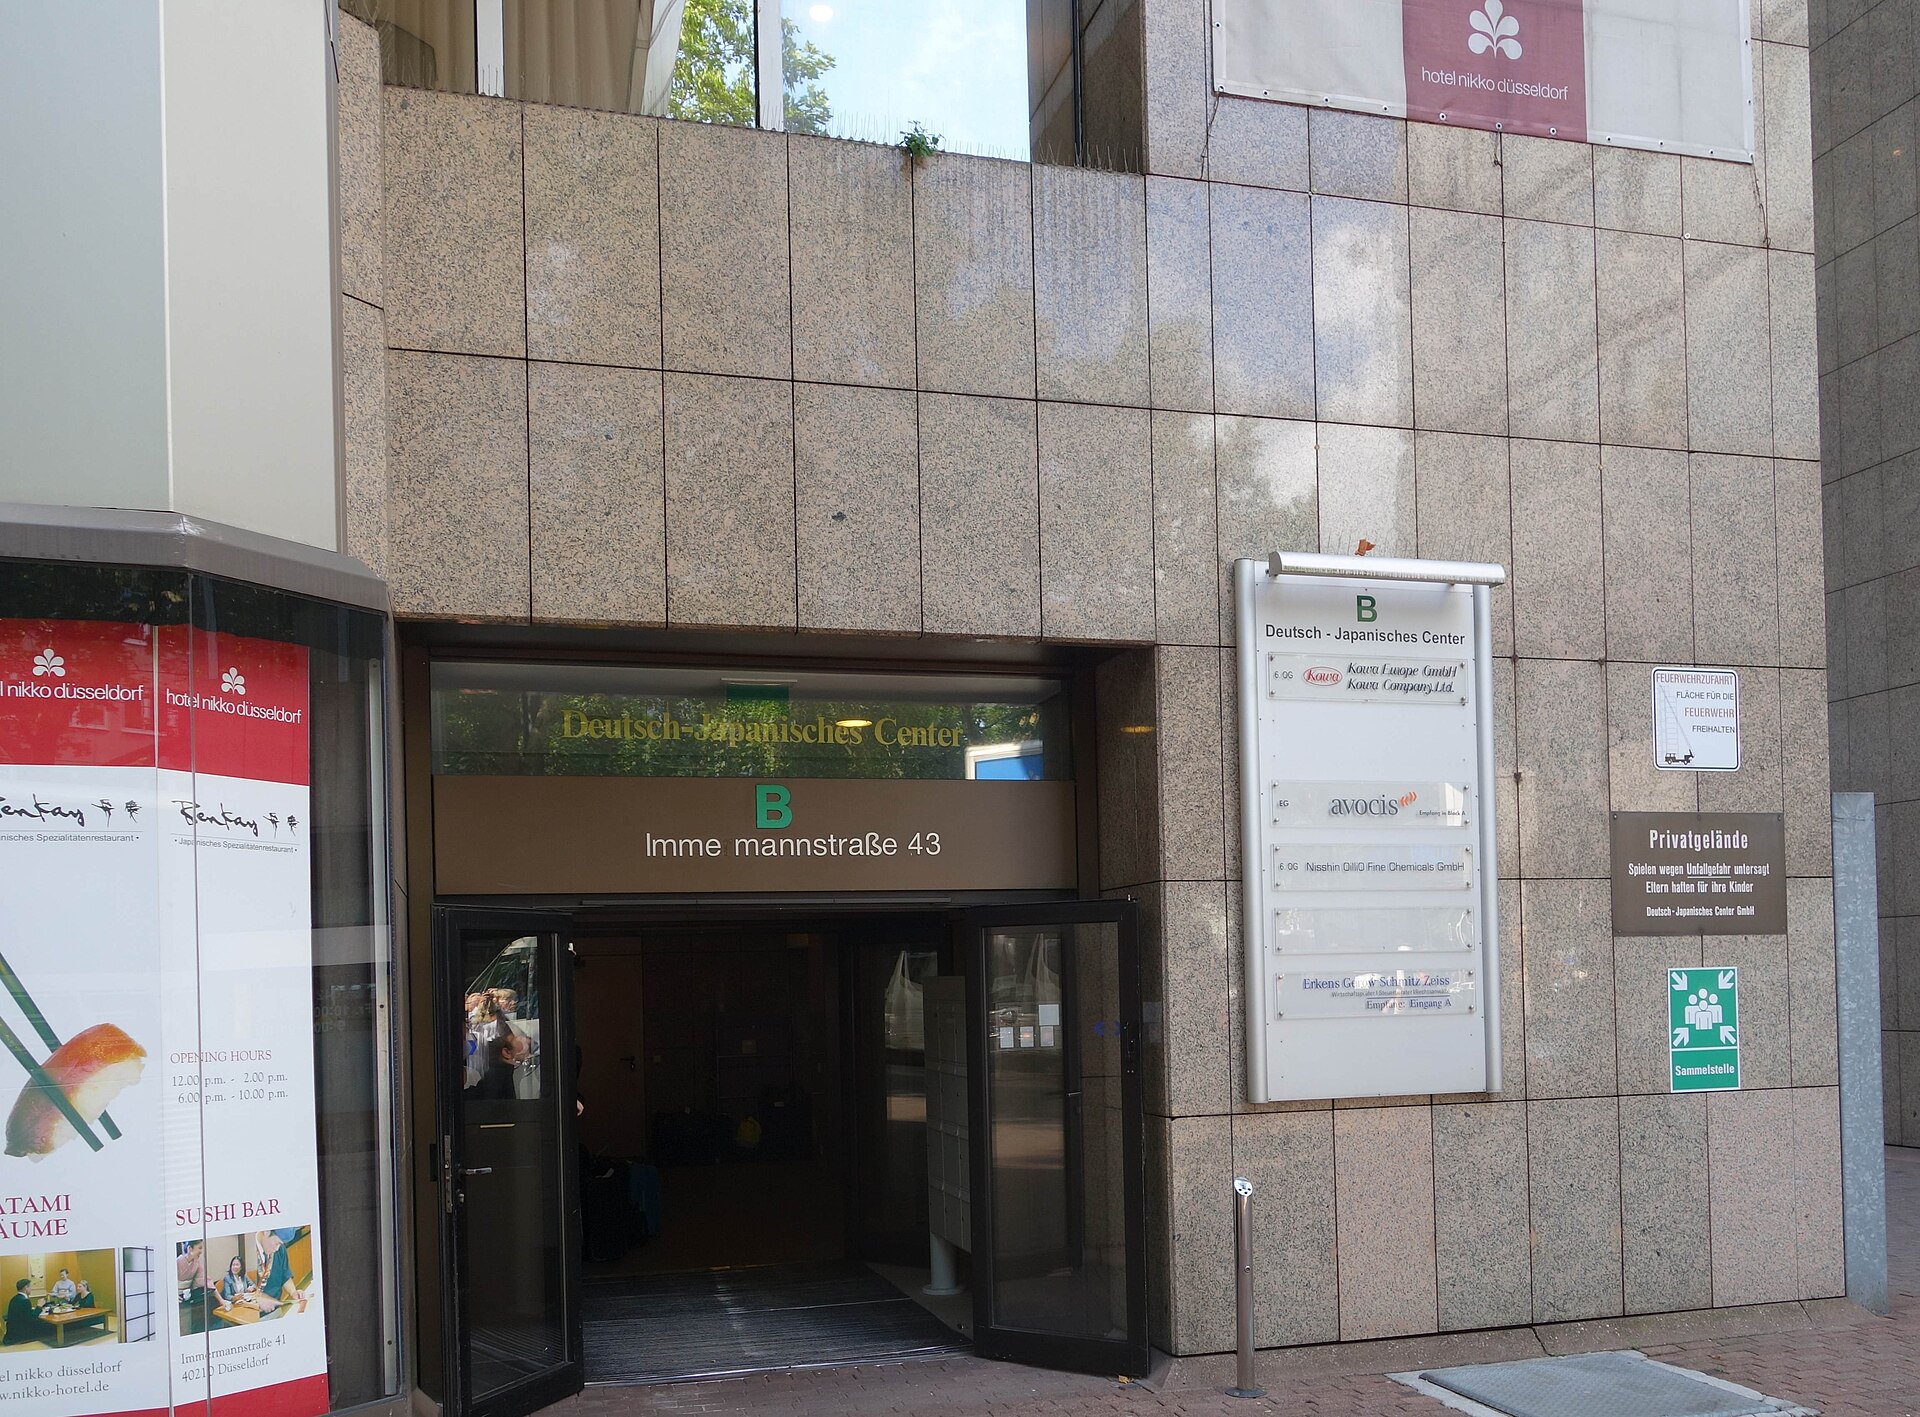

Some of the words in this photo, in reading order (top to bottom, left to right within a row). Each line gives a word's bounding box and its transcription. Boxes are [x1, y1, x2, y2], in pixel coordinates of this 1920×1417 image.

[1421, 67, 1456, 85] hotel
[1459, 73, 1495, 91] nikko
[1498, 78, 1568, 100] düsseldorf
[1356, 595, 1378, 622] B
[1265, 624, 1322, 639] Deutsch
[1334, 627, 1418, 643] Japanisches
[1422, 630, 1466, 645] Center
[1306, 669, 1340, 683] Kowa
[1347, 662, 1380, 675] Kowa
[1382, 663, 1418, 678] Europe
[1422, 664, 1457, 678] GmbH
[1347, 677, 1379, 690] Kowa
[1656, 673, 1734, 685] FEUERWEHRZUFAHRT
[8, 682, 52, 699] nikko
[54, 683, 144, 700] düsseldorf
[1676, 690, 1705, 699] FLÄCHE
[1707, 691, 1721, 699] FÜR
[166, 688, 200, 708] hotel
[202, 697, 235, 714] nikko
[237, 701, 302, 724] düsseldorf
[1685, 707, 1735, 718] FEUERWEHR
[562, 709, 862, 748] Deutsch-Japanisches
[875, 717, 964, 747] Center
[1692, 725, 1735, 733] FREIHALTEN
[0, 793, 85, 828] enkay
[755, 784, 794, 830] B
[1279, 799, 1289, 807] EG
[1331, 794, 1399, 815] avocis
[907, 832, 941, 856] 43
[1649, 830, 1748, 851] Privatgelände
[1306, 862, 1341, 872] Nisshin
[1367, 862, 1386, 872] Fine
[1389, 862, 1435, 872] Chemicals
[1437, 861, 1465, 872] GmbH
[1628, 863, 1657, 876] Spielen
[1659, 865, 1683, 876] wegen
[1686, 863, 1731, 876] Unfallgefahr
[1734, 863, 1770, 876] untersagt
[1646, 881, 1669, 893] Eltern
[1671, 881, 1695, 893] haften
[1697, 881, 1708, 893] für
[1711, 881, 1726, 893] ihre
[1729, 881, 1754, 893] Kinder
[1715, 906, 1735, 916] Center
[1737, 905, 1755, 916] GmbH
[1303, 978, 1340, 990] Erkens
[1423, 975, 1450, 986] Zeiss
[1409, 999, 1443, 1009] Eingang
[1444, 998, 1452, 1006] A
[170, 1051, 227, 1064] OPENING
[231, 1050, 272, 1062] HOURS
[1675, 1063, 1735, 1076] Sammelstelle
[172, 1074, 200, 1087] 12.00
[205, 1077, 226, 1087] p.m.
[244, 1072, 264, 1083] 2.00
[267, 1074, 288, 1084] p.m.
[178, 1092, 200, 1104] 6.00
[205, 1094, 227, 1104] p.m.
[239, 1088, 264, 1100] 10.00
[268, 1091, 288, 1101] p.m.
[175, 1203, 237, 1226] SUSHI
[242, 1198, 281, 1218] BAR
[181, 1337, 272, 1365] Immermannstraße
[275, 1334, 286, 1346] 41
[15, 1367, 53, 1381] nikko
[57, 1360, 123, 1377] düsseldorf
[181, 1365, 215, 1382] 40210
[218, 1353, 270, 1375] Düsseldorf
